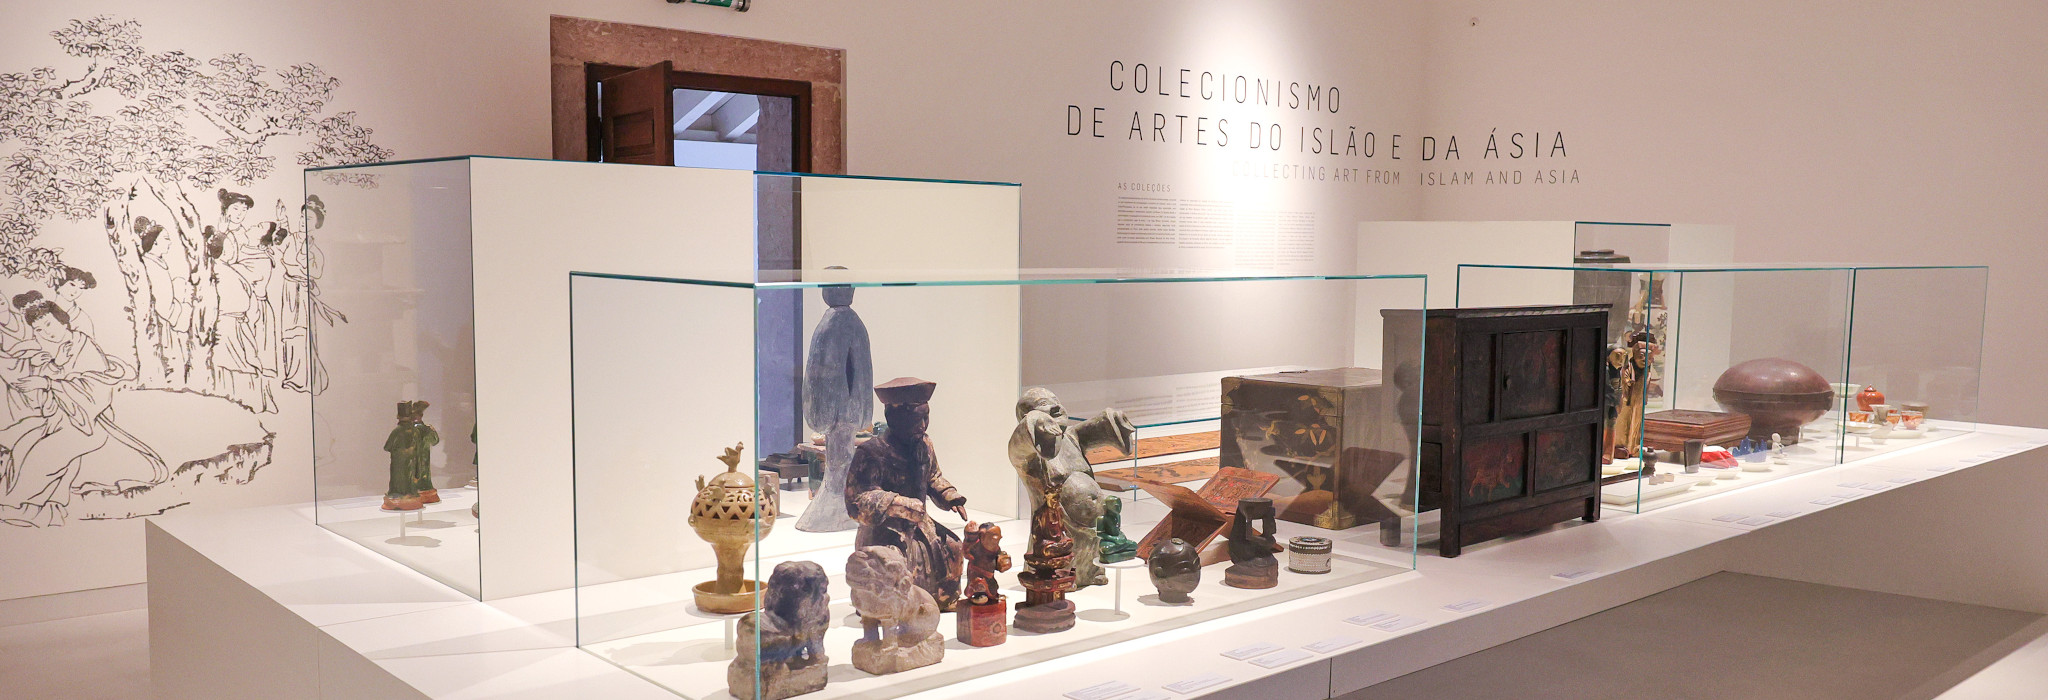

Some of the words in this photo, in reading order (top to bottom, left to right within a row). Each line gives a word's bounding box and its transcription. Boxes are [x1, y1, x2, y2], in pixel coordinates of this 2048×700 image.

[1110, 60, 1340, 113] COLECIONISMO
[1067, 105, 1105, 138] DE
[1129, 111, 1229, 147] ARTES
[1250, 122, 1282, 151] DO
[1300, 126, 1375, 158] ISLÃO
[1392, 134, 1401, 159] E
[1422, 136, 1460, 161] DA
[1483, 127, 1567, 159] ÁSIA
[1117, 182, 1128, 191] AS
[1131, 182, 1171, 193] COLEÇÕES
[1232, 160, 1325, 181] COLLECTING
[1333, 168, 1359, 182] ART
[1366, 169, 1400, 185] FROM
[1420, 171, 1474, 186] ISLAM
[1485, 170, 1522, 185] AND
[1534, 169, 1580, 184] ASIA
